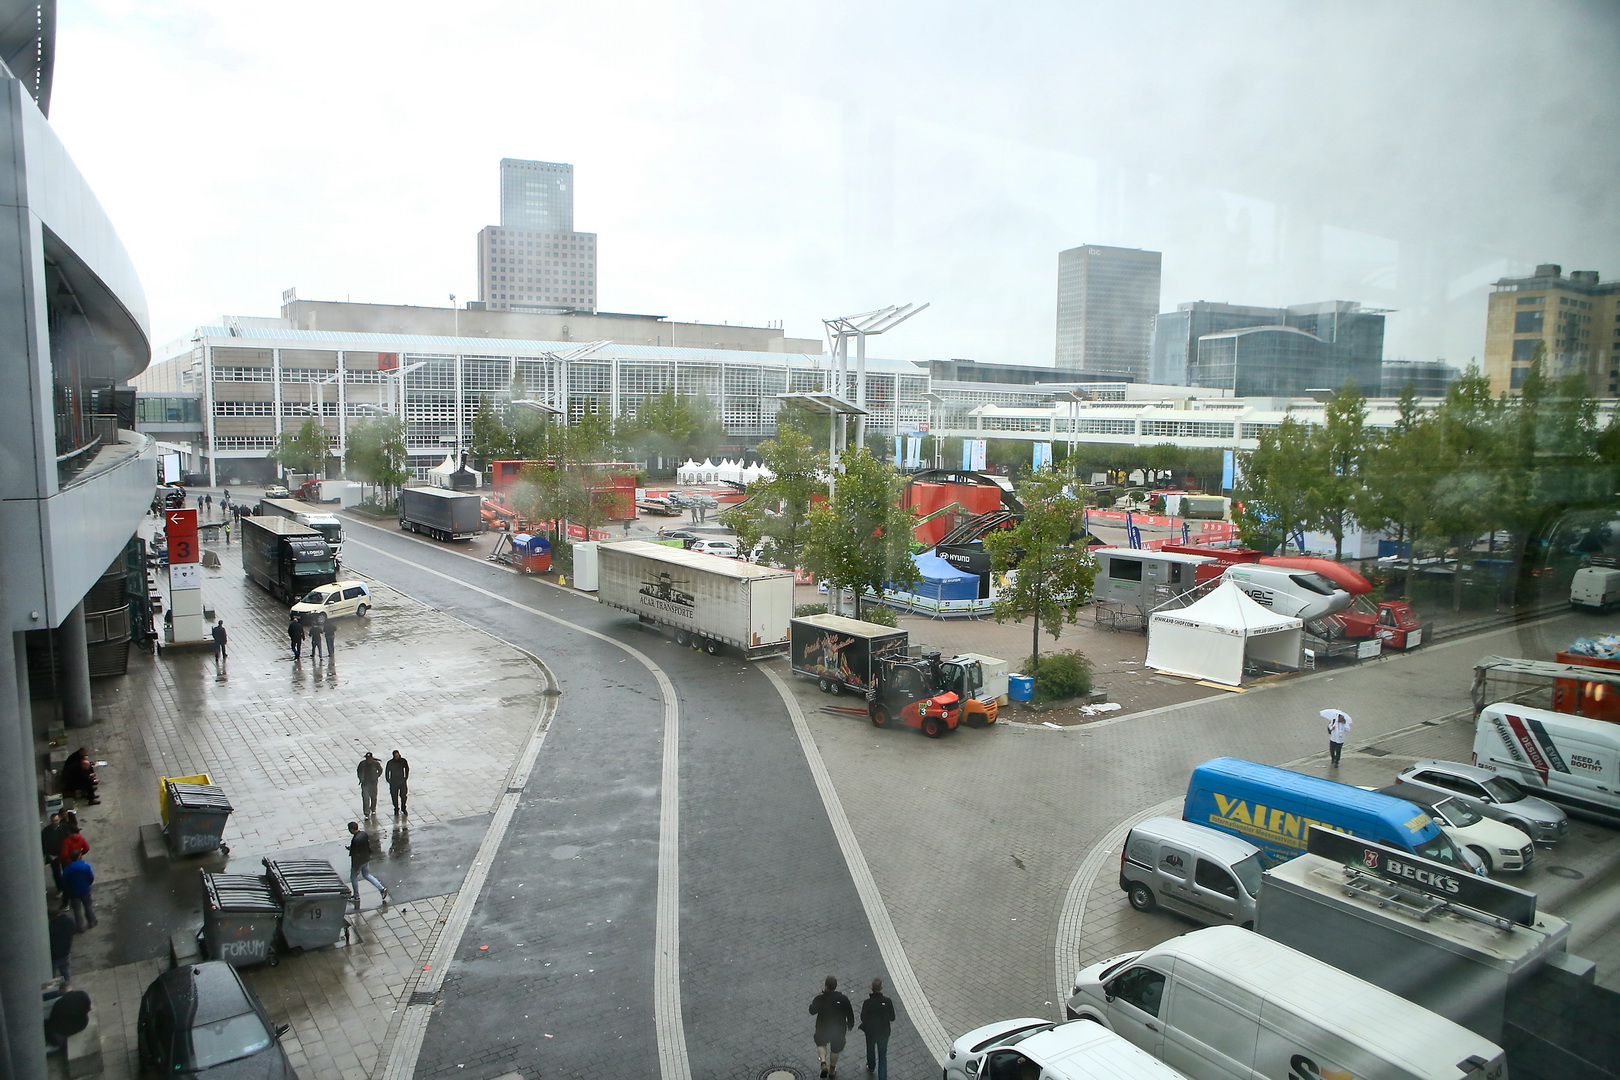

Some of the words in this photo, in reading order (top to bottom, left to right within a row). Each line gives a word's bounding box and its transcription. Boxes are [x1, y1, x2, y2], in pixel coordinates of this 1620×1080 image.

[382, 354, 393, 368] 4
[176, 541, 191, 558] 3
[640, 596, 655, 608] ACAR
[656, 600, 694, 619] TRANSPORTE
[1492, 717, 1522, 762] EXHIBITION
[1521, 736, 1544, 768] DESIGN
[1545, 745, 1565, 773] EVENT
[1571, 754, 1593, 764] NEED
[1570, 760, 1603, 772] BOOTH?
[1213, 792, 1353, 840] VALENT
[1211, 815, 1255, 834] Internationaler
[1256, 827, 1297, 845] Messeservice
[183, 834, 219, 850] FORUM
[1386, 859, 1460, 893] BECK'S
[309, 908, 322, 920] 19
[221, 939, 265, 960] FORUM
